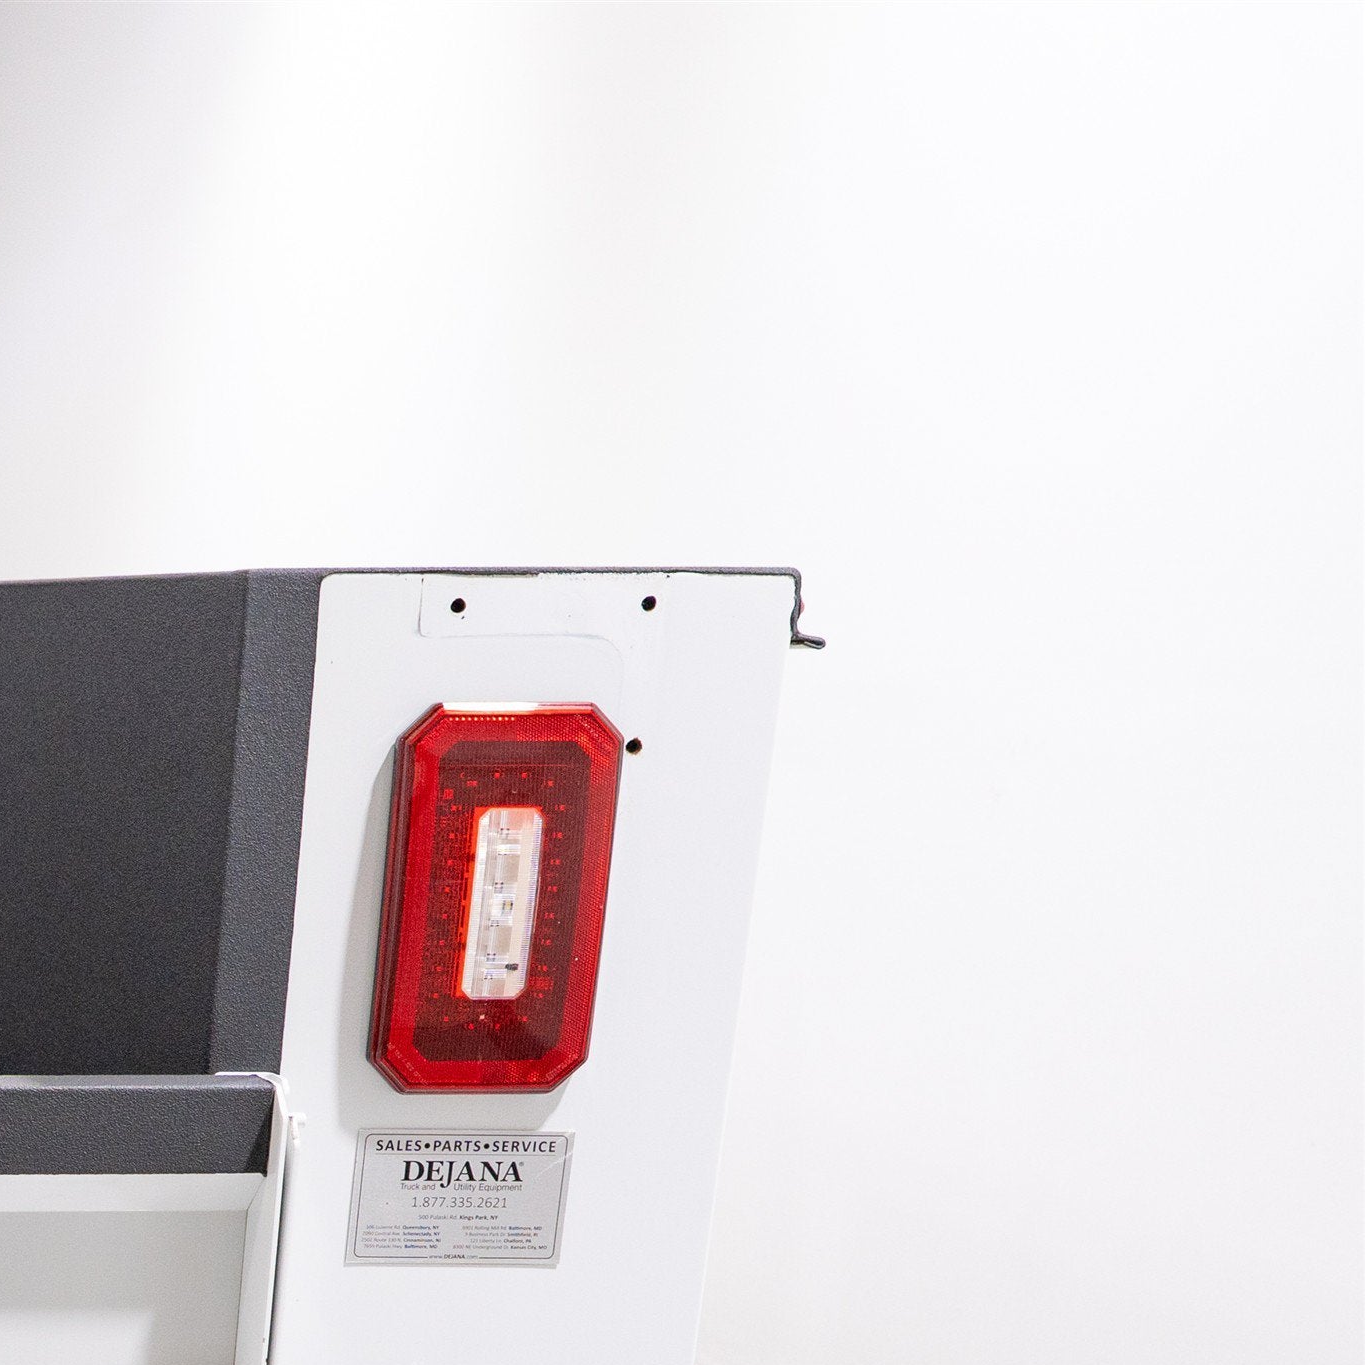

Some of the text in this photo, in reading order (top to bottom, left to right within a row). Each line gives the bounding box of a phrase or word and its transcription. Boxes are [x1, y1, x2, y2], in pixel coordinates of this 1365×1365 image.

[400, 1160, 523, 1189] DEJANA
[400, 1183, 523, 1193] Truck and Utility Equipment
[411, 1196, 508, 1209] 1.877.335.2621
